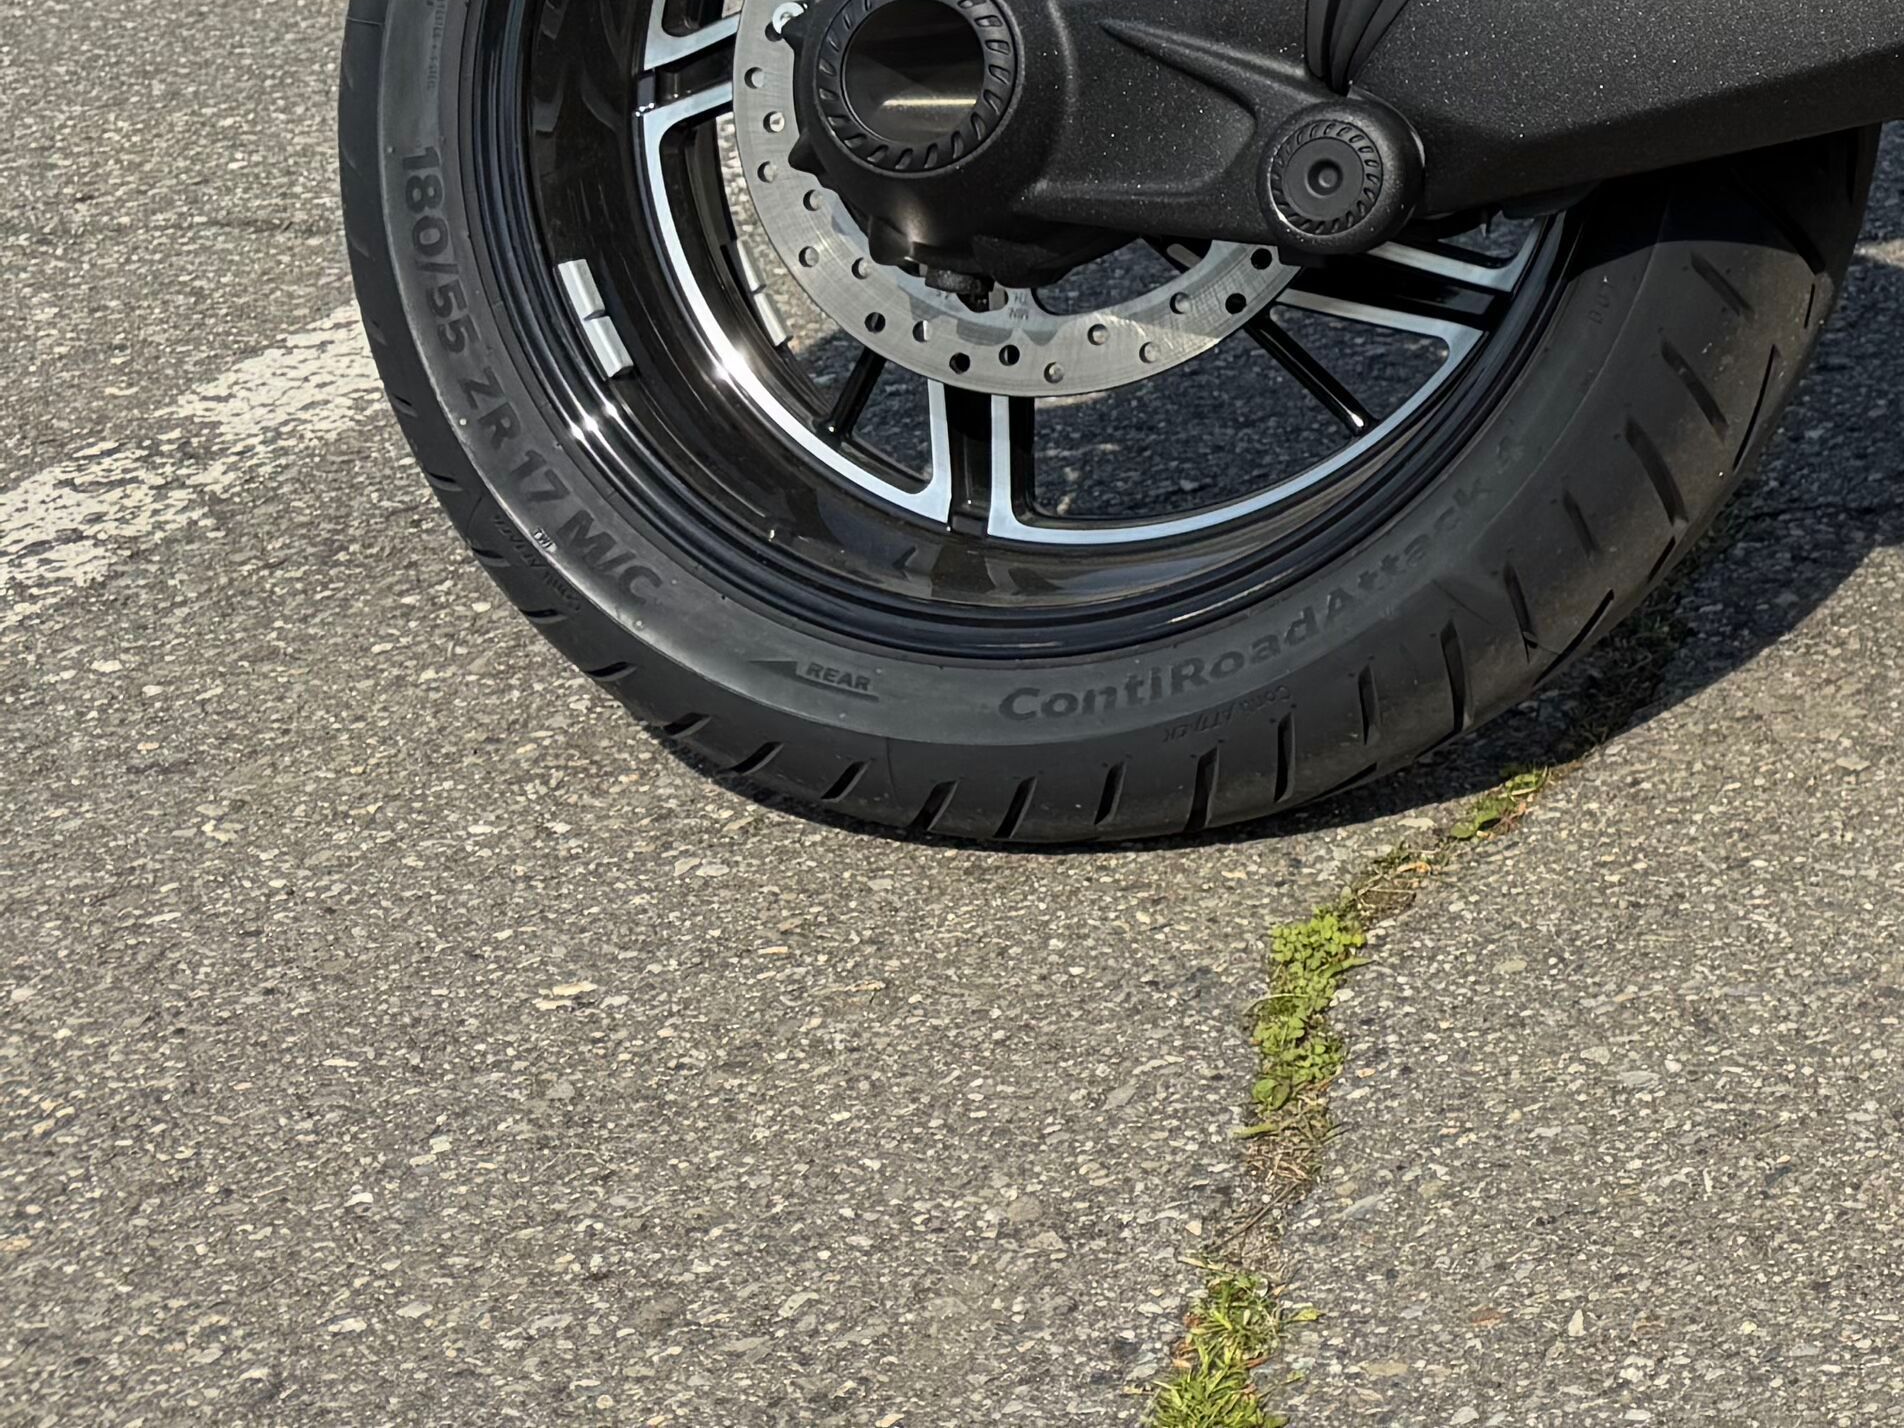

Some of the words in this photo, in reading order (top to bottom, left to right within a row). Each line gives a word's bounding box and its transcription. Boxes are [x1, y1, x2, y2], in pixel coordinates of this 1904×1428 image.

[402, 146, 480, 354] 180/55
[457, 366, 523, 444] ZR
[511, 449, 571, 504] 17
[557, 509, 662, 606] M/C
[805, 660, 872, 693] REAR
